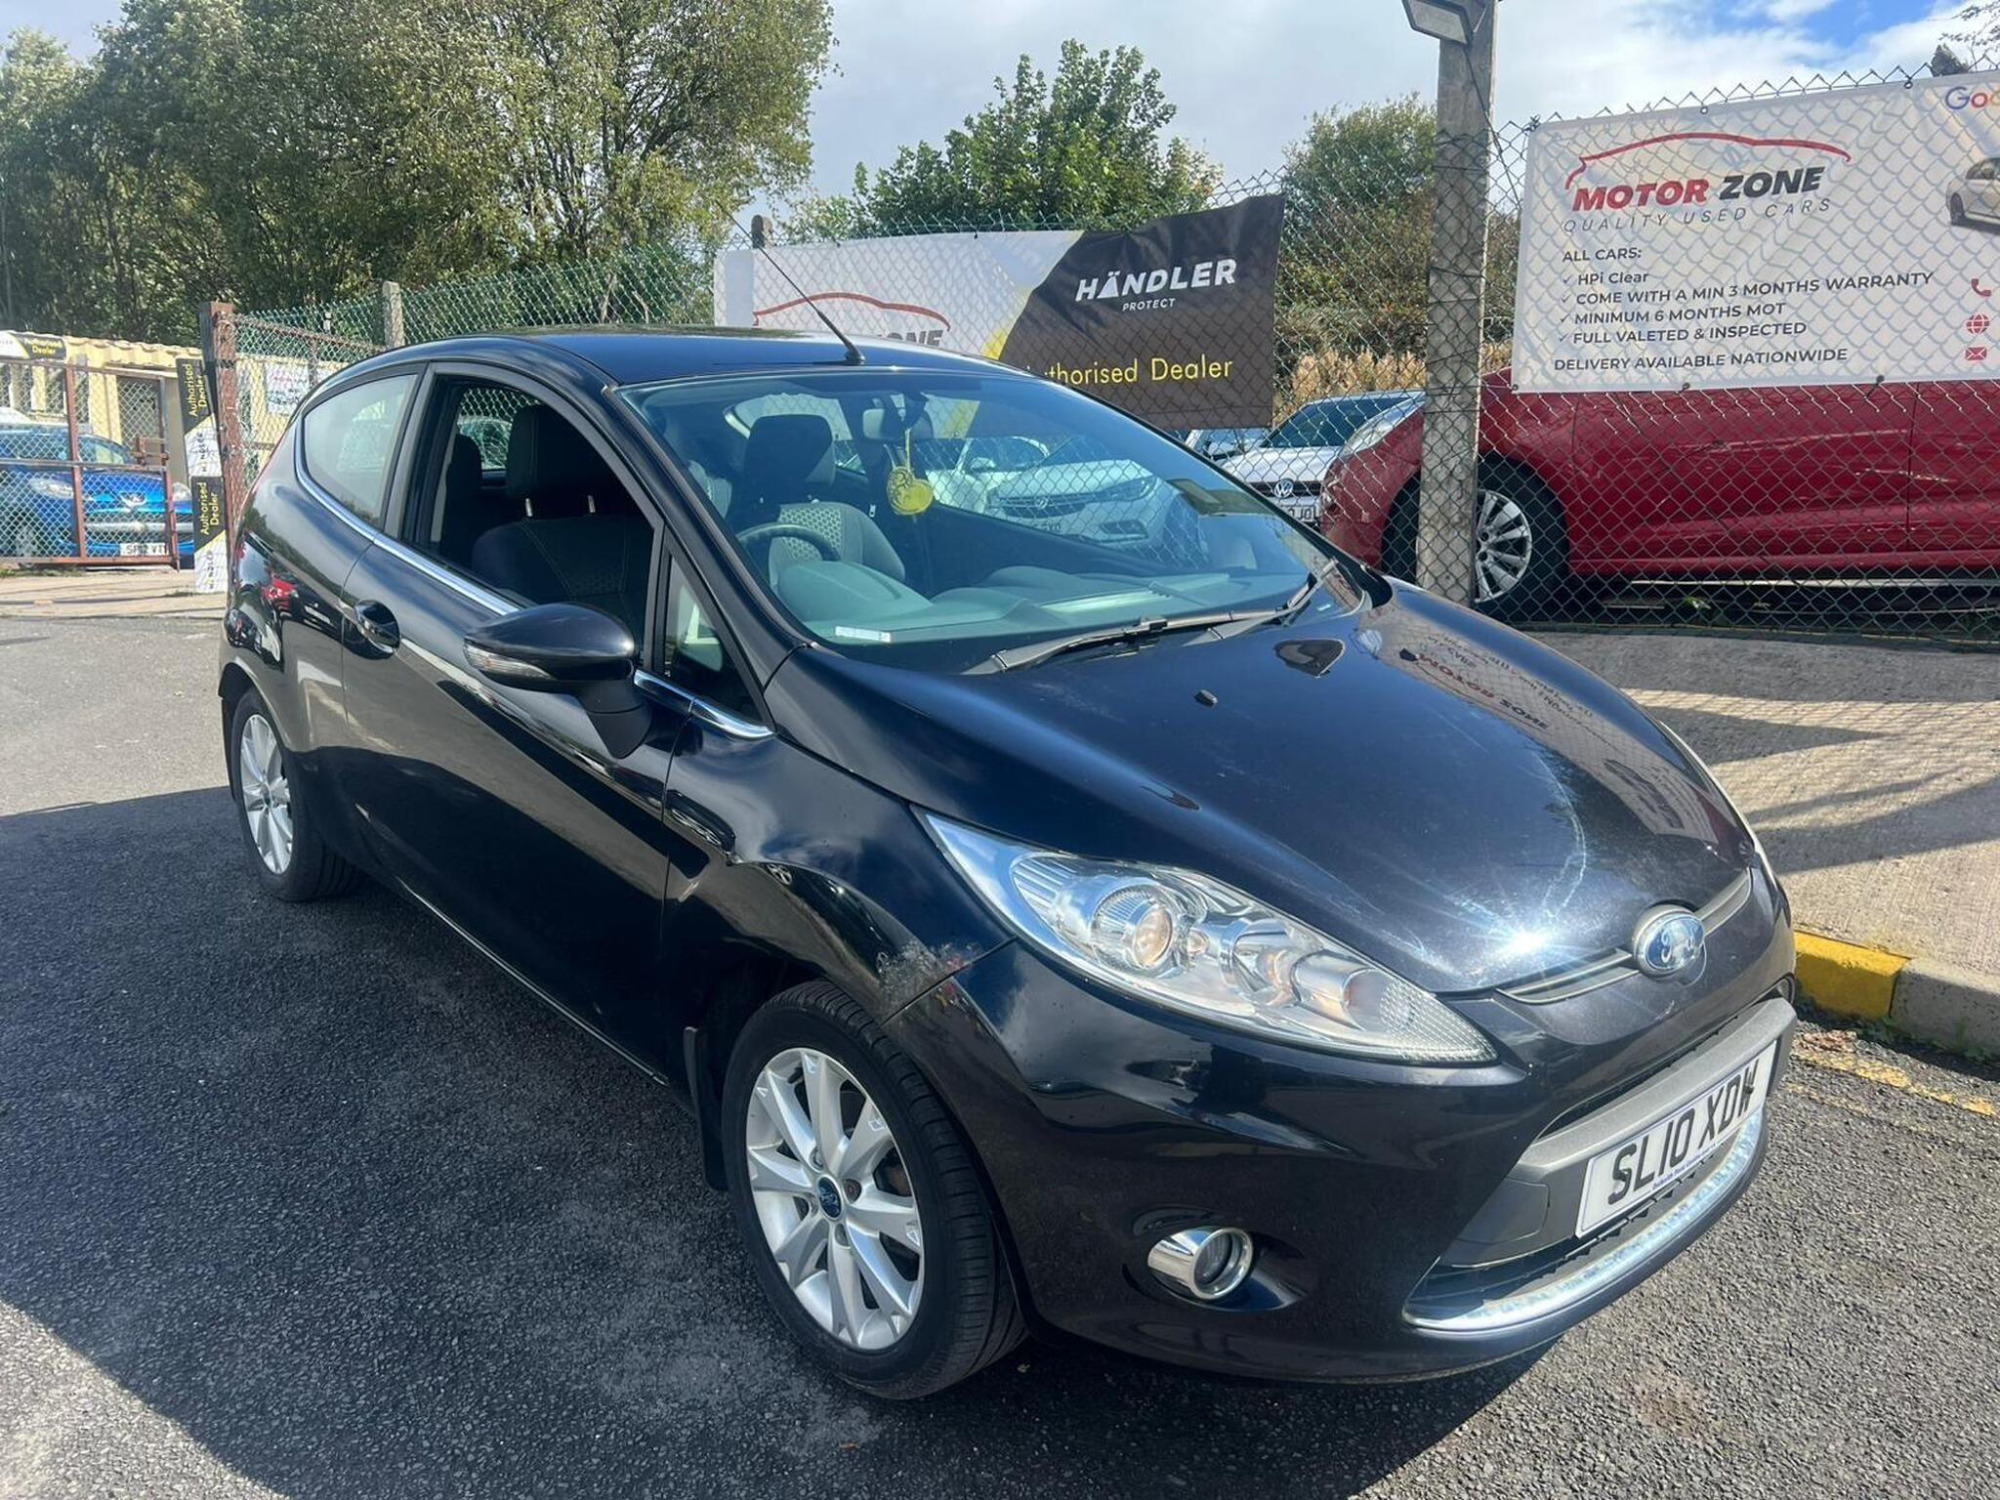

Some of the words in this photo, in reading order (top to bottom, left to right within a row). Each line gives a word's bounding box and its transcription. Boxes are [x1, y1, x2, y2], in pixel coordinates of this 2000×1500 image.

[1572, 179, 1710, 212] MOTOR
[1719, 166, 1825, 200] ZONE
[1563, 212, 1667, 233] QUALITY
[1684, 208, 1746, 225] USED
[1765, 198, 1831, 219] CARS
[1562, 250, 1590, 263] ALL
[1595, 247, 1642, 261] CARS:
[1075, 258, 1237, 302] HÄNDLER
[1576, 292, 1622, 305] COME
[1627, 290, 1671, 303] WITH
[1675, 289, 1687, 301] A
[1692, 287, 1724, 300] MIN
[1728, 285, 1738, 297] 3
[1743, 279, 1820, 296] MONTHS
[1825, 272, 1935, 291] WARRANTY
[1578, 272, 1603, 286] HPi
[1608, 272, 1649, 285] Clear
[1122, 298, 1176, 312] PROTECT
[1574, 311, 1649, 325] MINIMUM
[1654, 310, 1664, 322] 6
[1668, 305, 1741, 321] MONTHS
[1746, 302, 1787, 317] MOT
[1573, 332, 1611, 344] FULL
[1616, 329, 1689, 342] VALETED
[1693, 328, 1705, 340] &
[1709, 322, 1807, 339] INSPECTED
[1044, 358, 1138, 385] thorised
[1151, 353, 1233, 381] Dealer
[1554, 357, 1630, 371] DELIVERY
[1634, 354, 1725, 369] AVAILABLE
[1730, 348, 1848, 365] NATIONWIDE
[182, 363, 199, 417] Authorised
[197, 482, 210, 536] Authorised
[208, 493, 220, 526] Dealer
[1607, 1107, 1696, 1205] SL10
